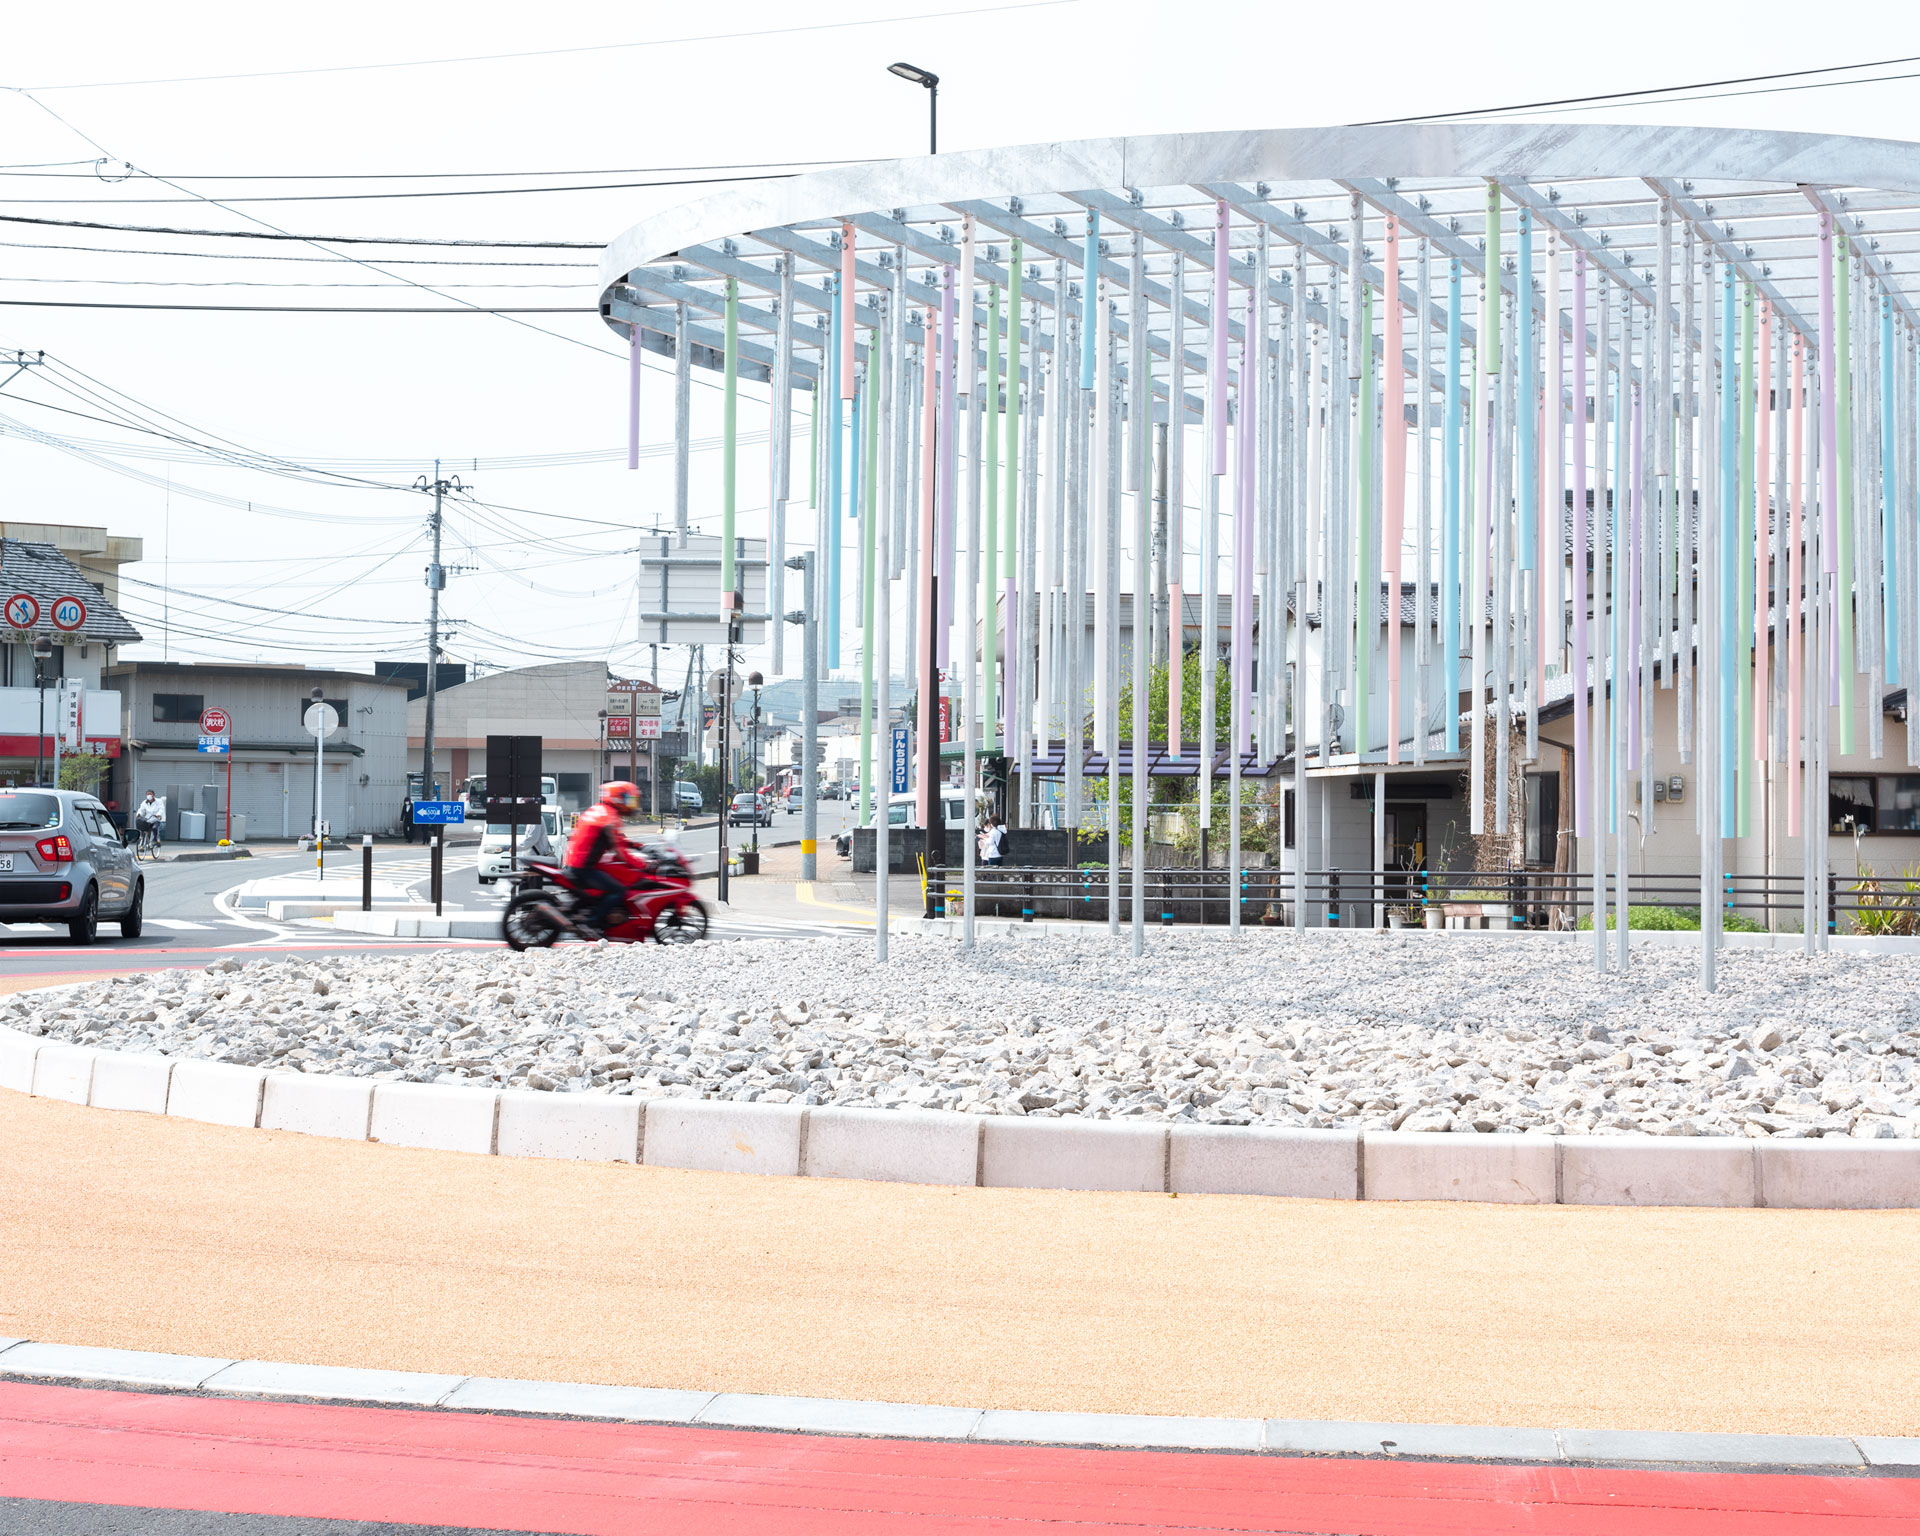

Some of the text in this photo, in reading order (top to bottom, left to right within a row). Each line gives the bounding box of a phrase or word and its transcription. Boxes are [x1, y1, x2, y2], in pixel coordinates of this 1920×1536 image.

[59, 606, 78, 621] 40
[206, 718, 225, 727] 消火栓
[442, 804, 462, 815] 院内
